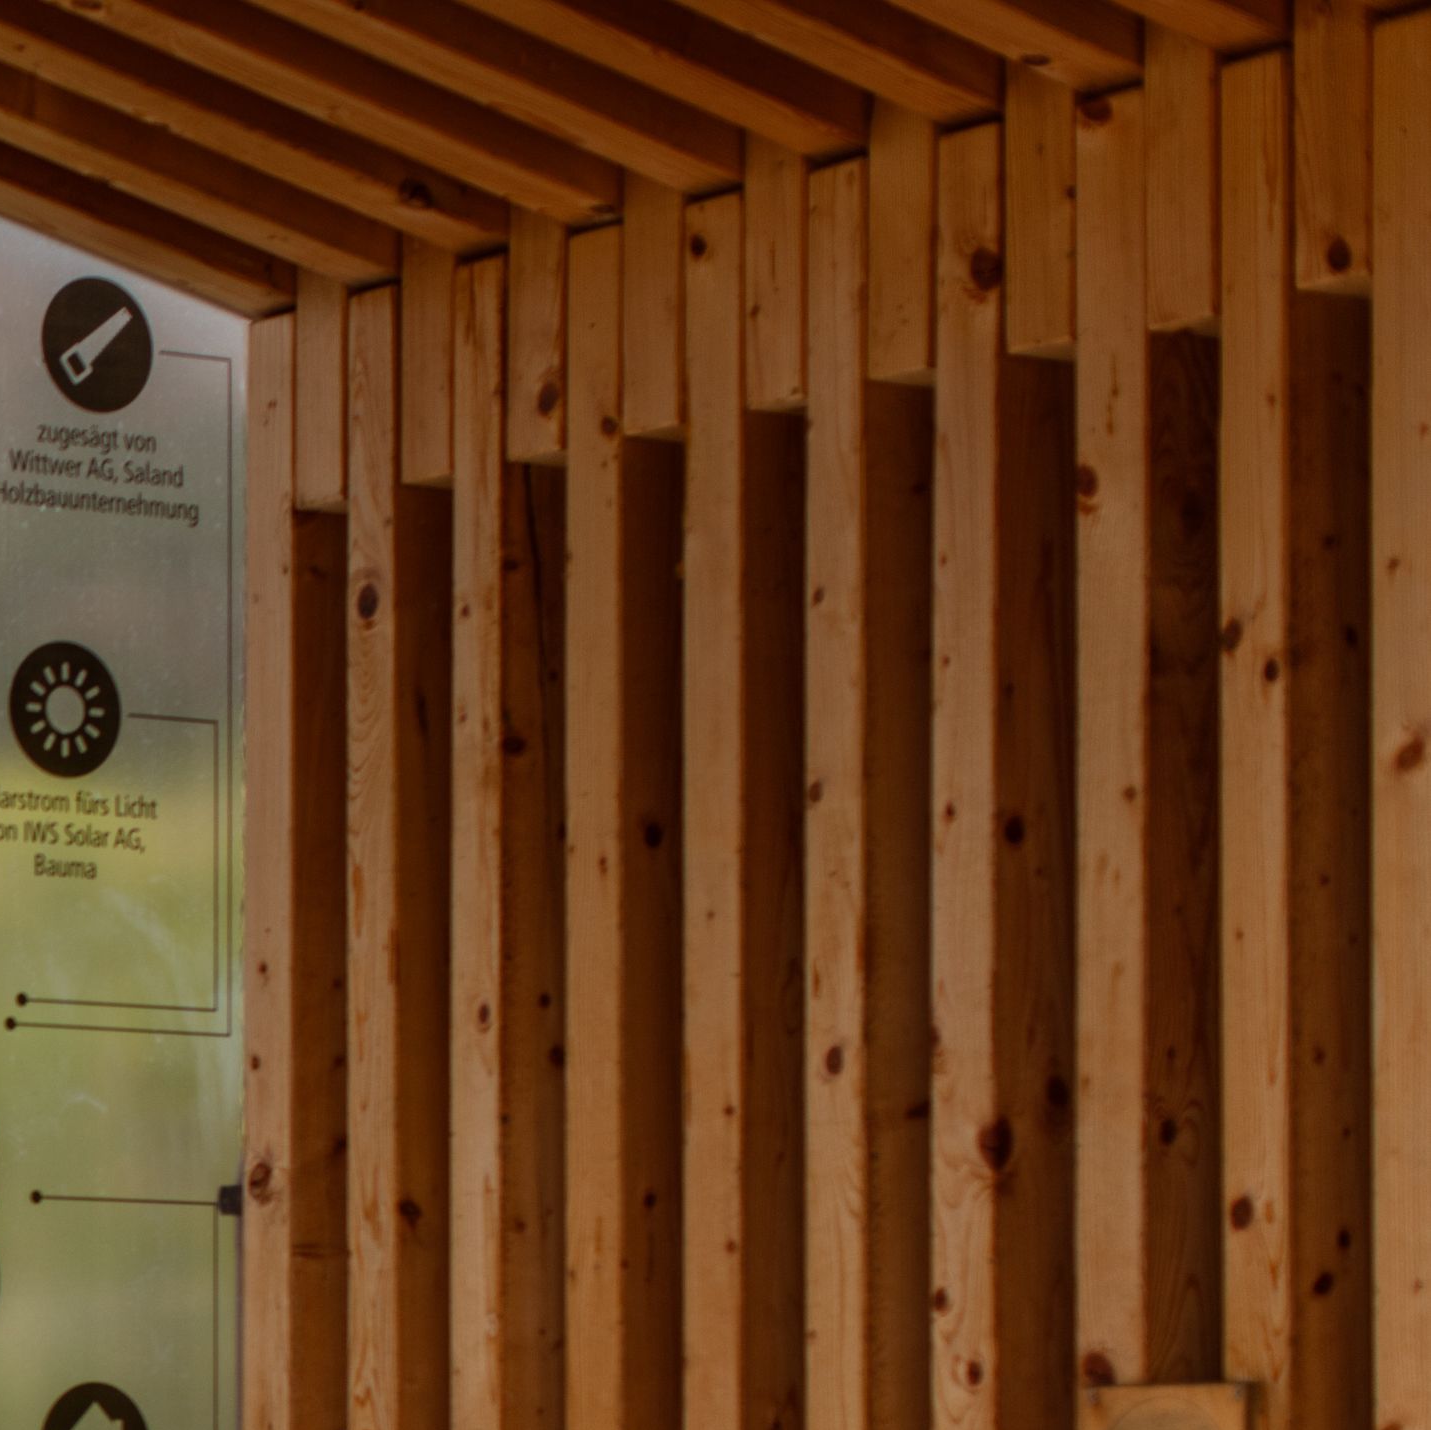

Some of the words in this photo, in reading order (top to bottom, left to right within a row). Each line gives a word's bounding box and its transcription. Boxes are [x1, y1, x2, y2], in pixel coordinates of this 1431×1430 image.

[37, 424, 118, 455] zugesägt
[124, 434, 157, 453] von
[10, 449, 81, 478] Wittwer
[86, 457, 118, 484] AG,
[123, 463, 183, 488] Saland
[76, 790, 109, 816] fürs
[115, 794, 158, 820] Licht
[23, 821, 59, 845] IWS
[64, 822, 110, 848] Solar
[113, 827, 145, 854] AG,
[33, 853, 98, 880] Bauma
